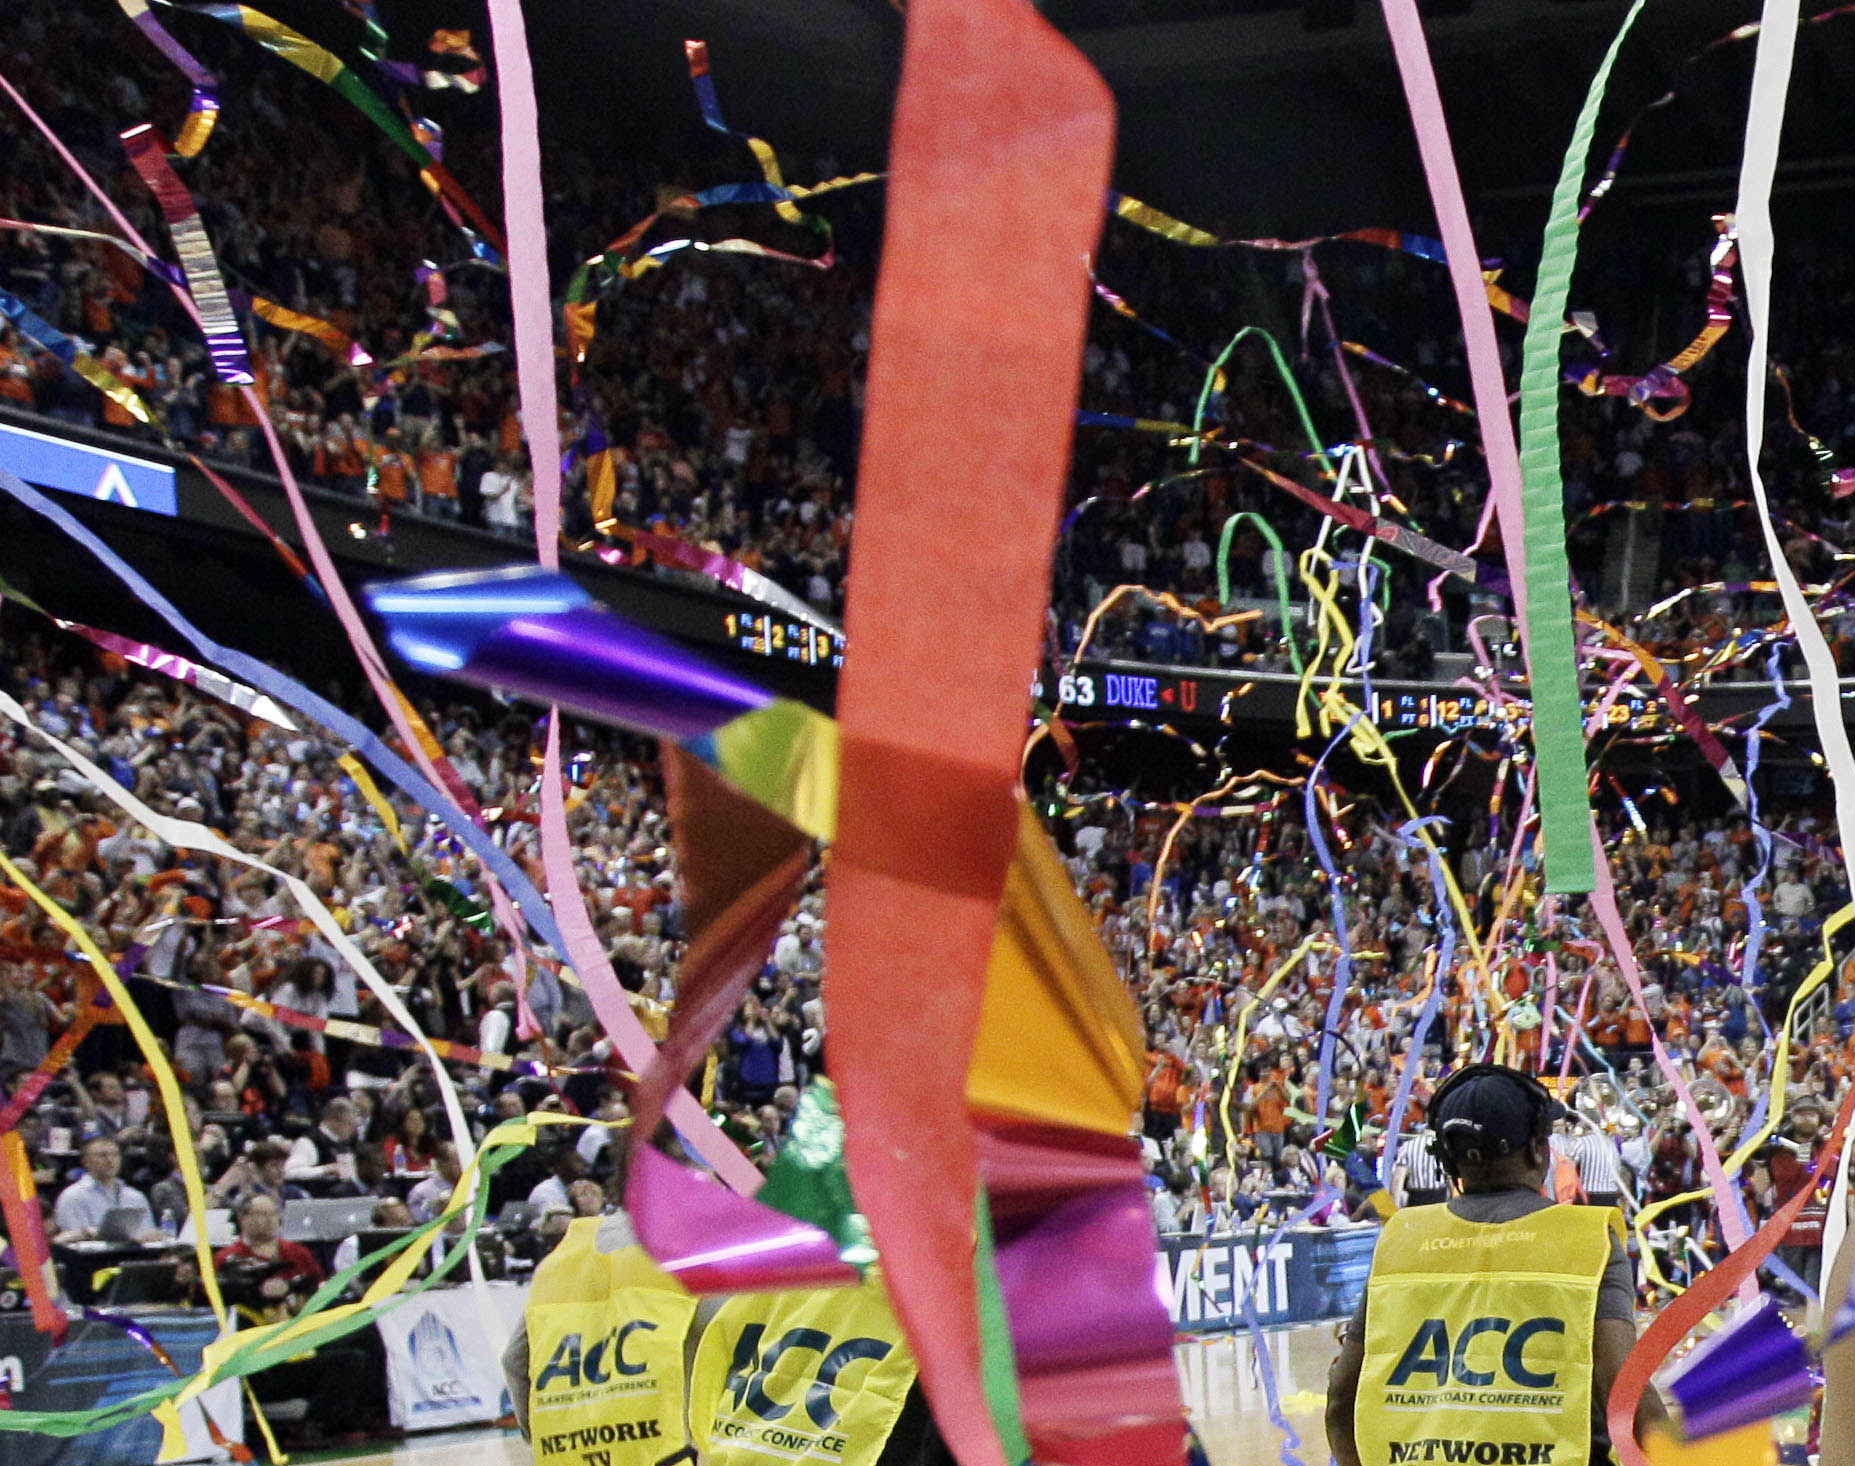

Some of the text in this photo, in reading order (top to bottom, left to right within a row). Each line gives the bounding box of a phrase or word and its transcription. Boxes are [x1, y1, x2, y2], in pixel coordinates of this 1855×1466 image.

[1058, 674, 1095, 706] 63
[1105, 674, 1159, 710] DUKE
[1381, 700, 1393, 719] 1
[1437, 700, 1460, 720] 12
[1608, 705, 1630, 724] 23
[1385, 1317, 1566, 1388] ACC
[724, 1323, 894, 1431] ACC
[1478, 1393, 1563, 1406] CONFERENCE
[540, 1419, 661, 1456] NETWORK
[1389, 1438, 1555, 1466] NETWORK
